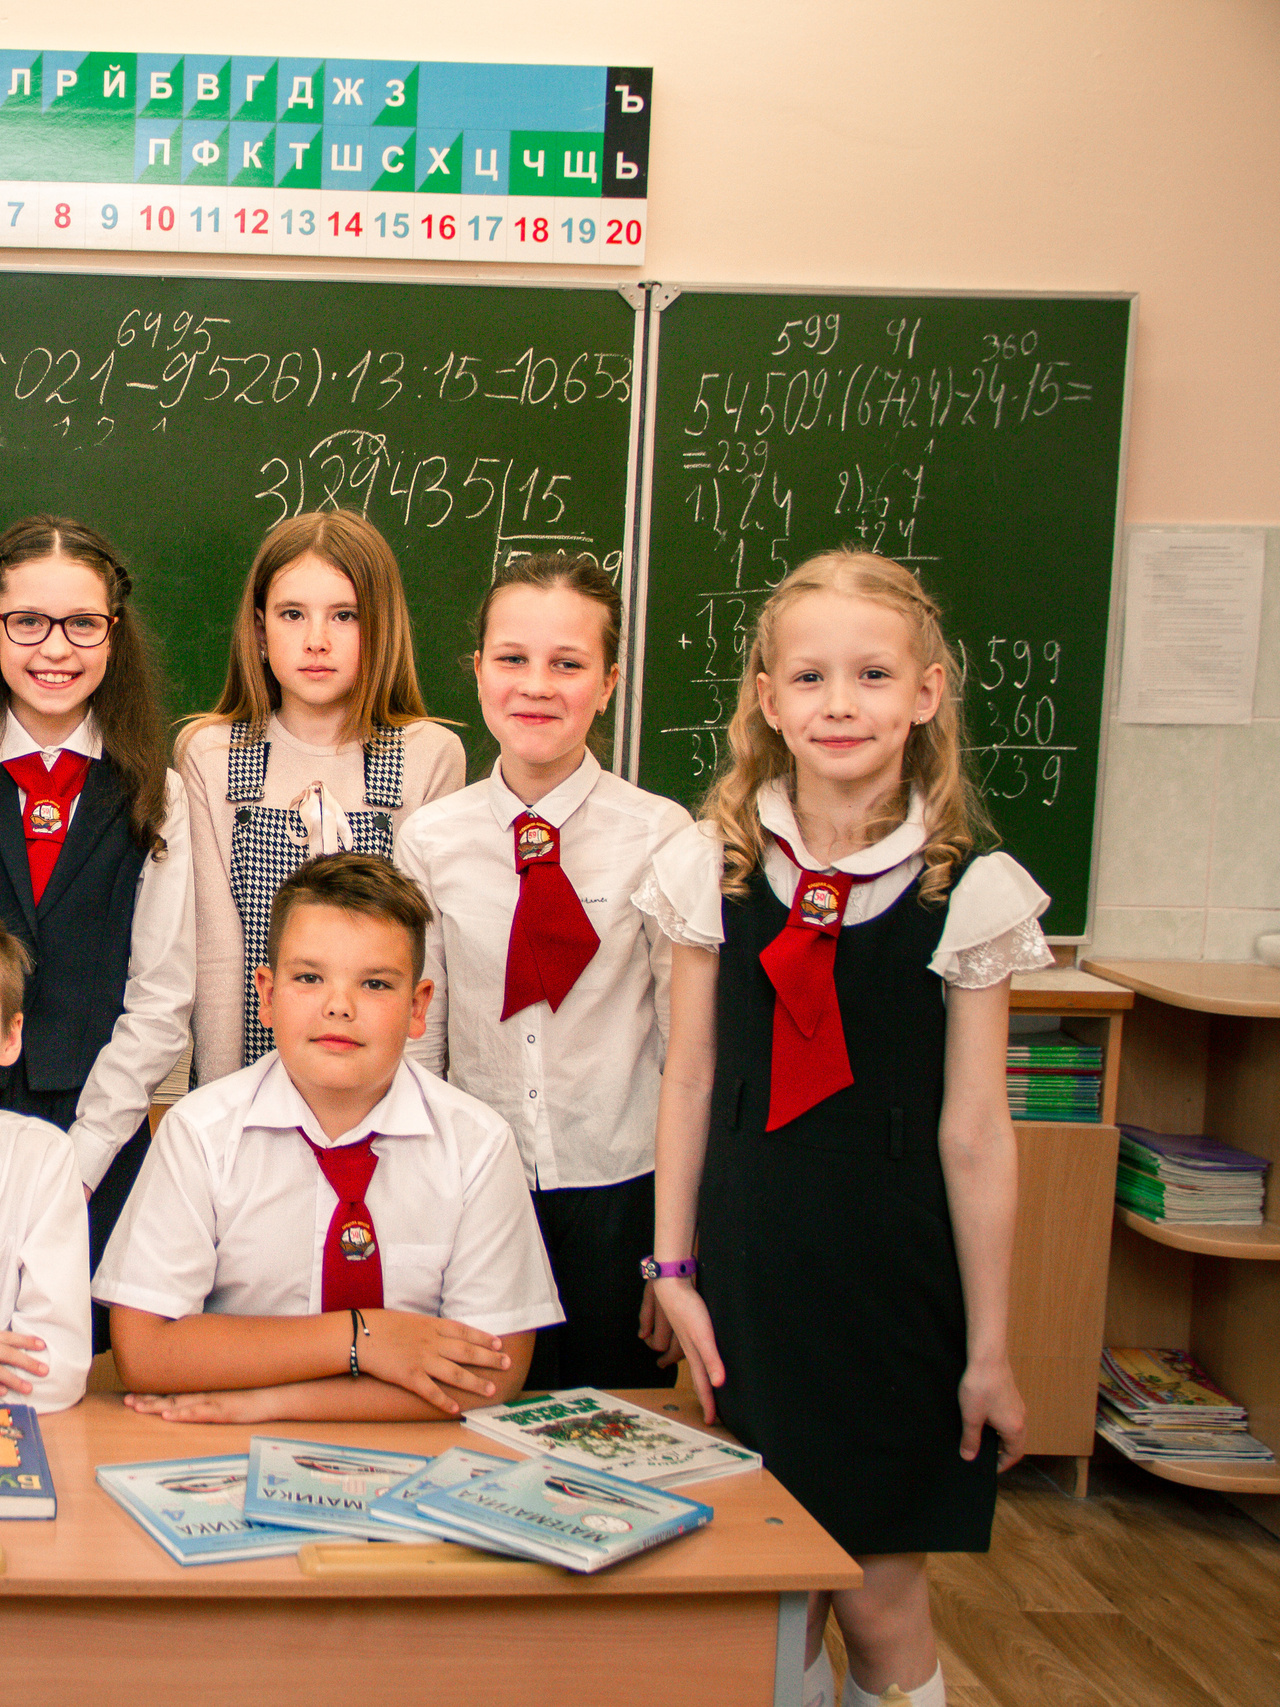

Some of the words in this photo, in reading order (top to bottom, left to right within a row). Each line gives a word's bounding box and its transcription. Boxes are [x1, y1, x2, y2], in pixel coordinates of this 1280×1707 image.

[8, 68, 31, 95] Л
[57, 70, 78, 96] Р
[104, 64, 125, 98] Й
[150, 72, 173, 99] Б
[197, 73, 220, 100] В
[246, 75, 265, 101] Г
[288, 76, 314, 109] Д
[332, 78, 364, 105] Ж
[385, 79, 406, 107] З
[615, 85, 644, 113] Ъ
[148, 138, 171, 165] П
[191, 139, 220, 166] Ф
[243, 141, 263, 168] К
[289, 143, 310, 169] Т
[331, 144, 363, 172] Ш
[382, 145, 404, 173] С
[427, 147, 451, 174] Х
[475, 149, 498, 181] Ц
[523, 150, 544, 177] Ч
[564, 151, 597, 184] Щ
[615, 152, 639, 180] Ь
[7, 201, 25, 226] 7
[54, 202, 71, 228] 8
[101, 204, 118, 229] 9
[140, 205, 175, 231] 10
[190, 206, 220, 233] 11
[234, 208, 269, 234] 12
[280, 209, 316, 235] 13
[327, 211, 363, 237] 14
[374, 212, 410, 238] 15
[421, 214, 456, 240] 16
[468, 216, 503, 241] 17
[514, 217, 549, 243] 18
[561, 218, 596, 244] 19
[606, 219, 642, 245] 20
[117, 309, 231, 355] 6495
[772, 313, 840, 356] 599
[982, 330, 1038, 362] 360
[519, 467, 571, 523] 15
[980, 635, 1060, 690] 599
[987, 695, 1055, 745] 360
[979, 747, 1061, 806] 239
